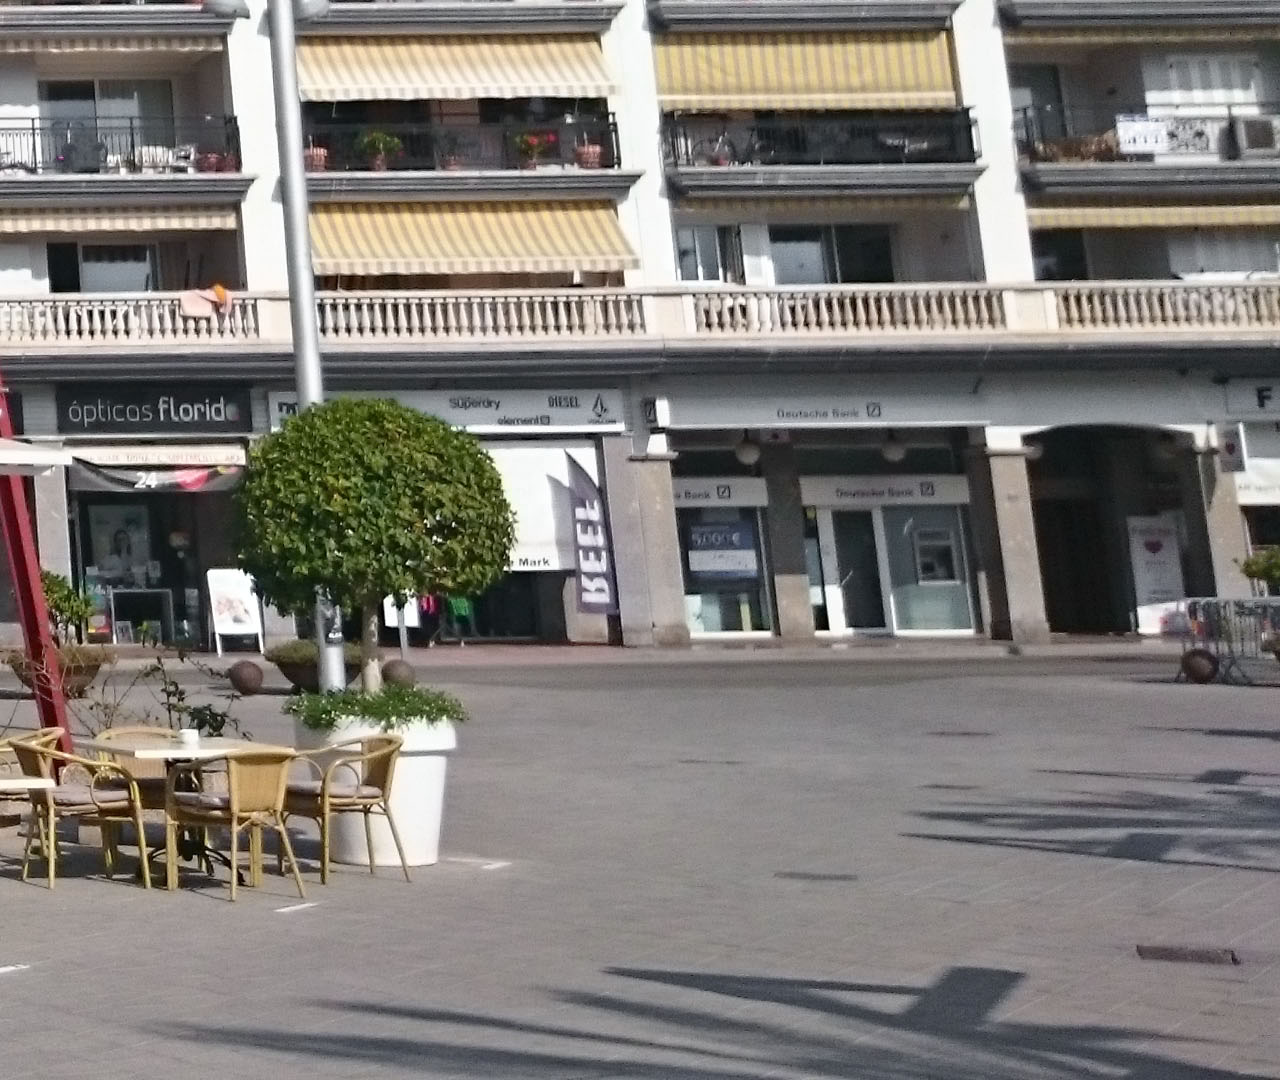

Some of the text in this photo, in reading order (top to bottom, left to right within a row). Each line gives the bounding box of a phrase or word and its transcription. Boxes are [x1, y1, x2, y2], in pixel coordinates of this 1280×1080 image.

[547, 395, 581, 408] DIESEL
[68, 400, 153, 427] ópticas
[575, 499, 610, 603] REEF
[518, 557, 551, 567] Mark
